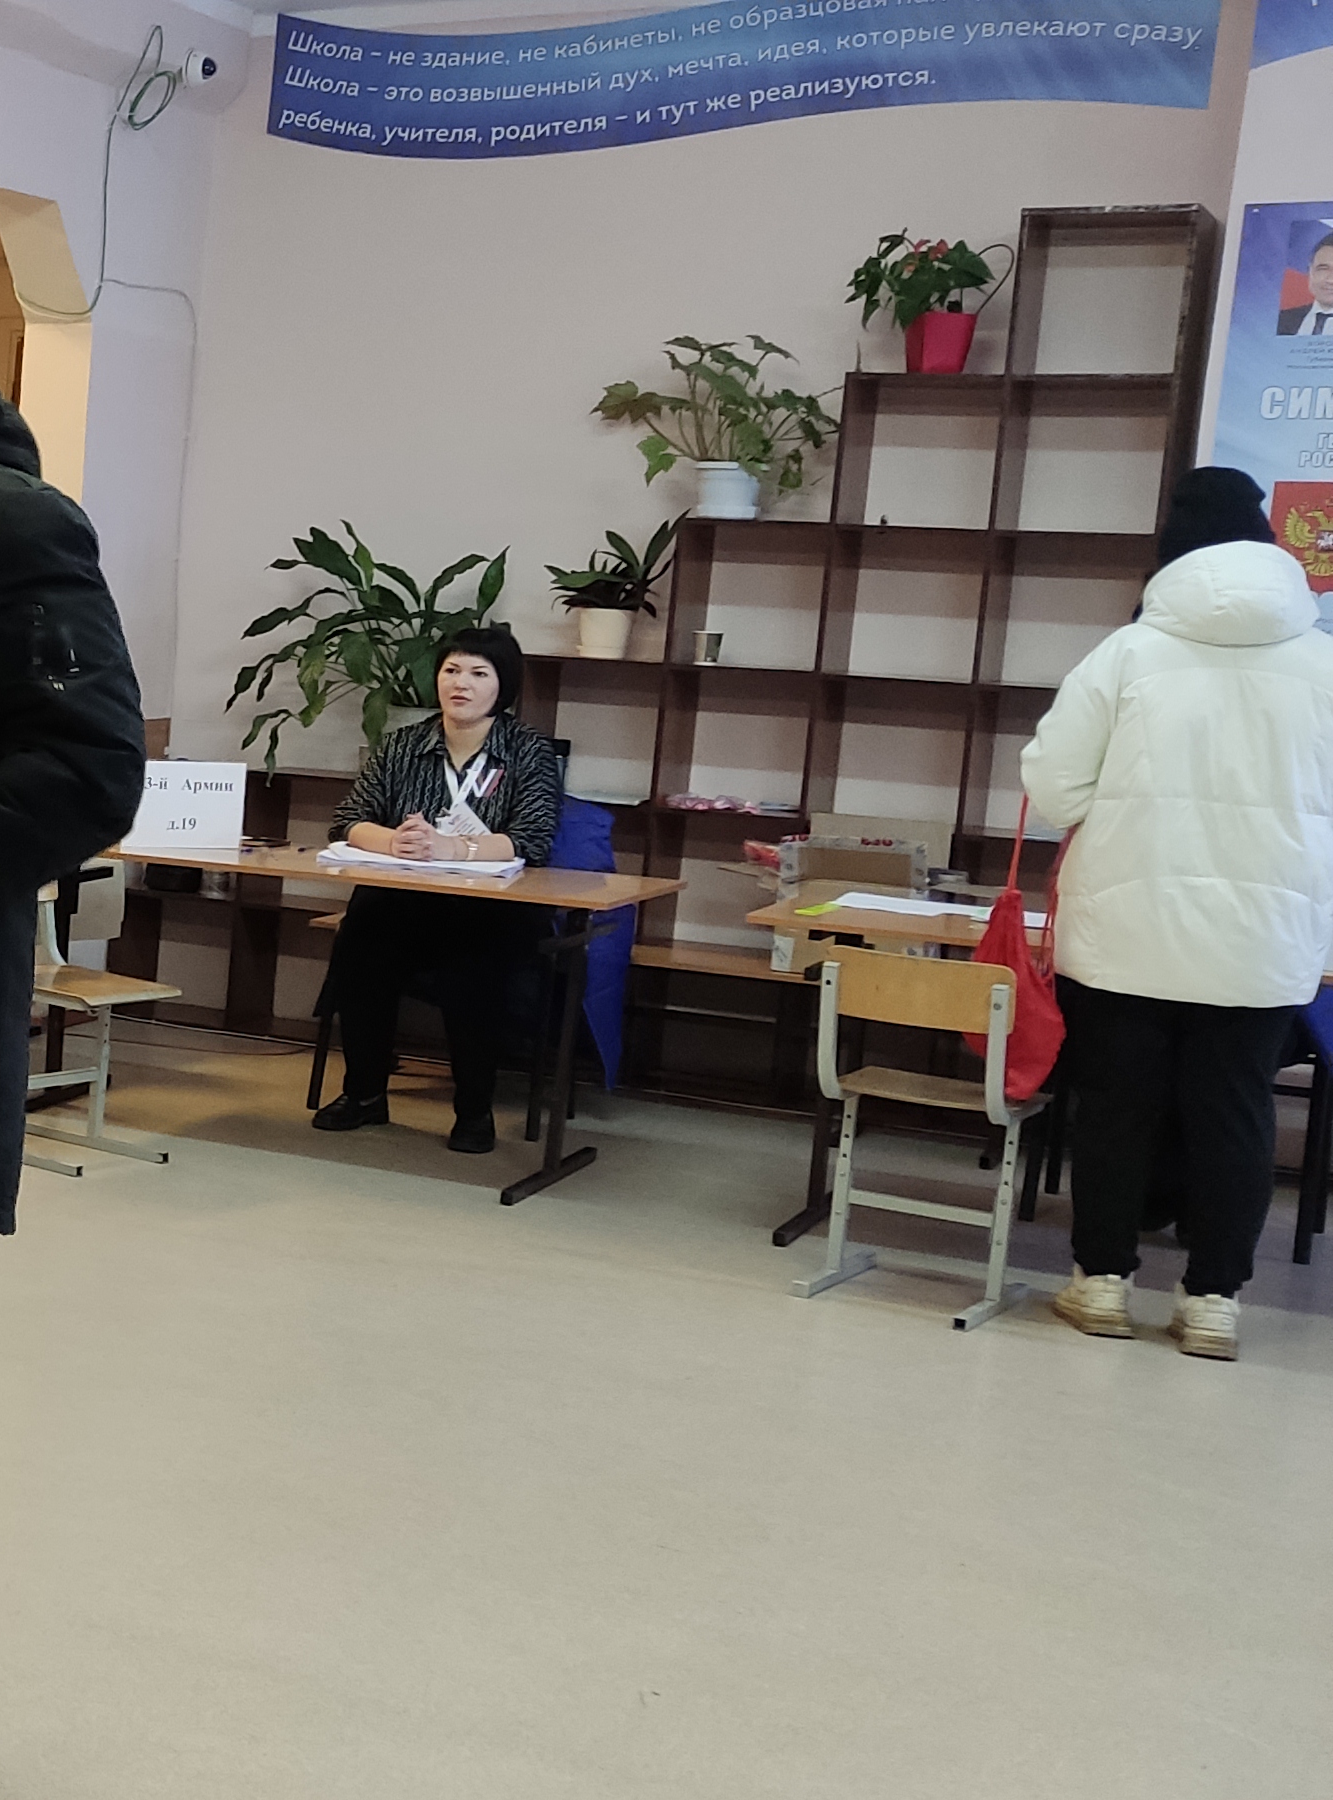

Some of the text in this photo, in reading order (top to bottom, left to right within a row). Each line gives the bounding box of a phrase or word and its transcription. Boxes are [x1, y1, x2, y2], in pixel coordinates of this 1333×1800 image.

[284, 65, 359, 96] Школа
[384, 86, 423, 102] это
[430, 72, 601, 102] возвышенный
[609, 70, 659, 92] дух,
[758, 38, 827, 62] идея,
[836, 24, 955, 49] которые
[963, 19, 1106, 45] увлекают
[288, 30, 363, 61] Школа
[388, 50, 415, 65] не
[421, 50, 511, 69] здание,
[519, 46, 546, 62] не
[554, 27, 682, 59] кабинеты,
[691, 18, 721, 37] не
[278, 108, 376, 140] ребенка,
[382, 124, 482, 146] учителя,
[490, 113, 606, 147] родителя
[636, 109, 650, 125] и
[658, 100, 698, 125] тут
[706, 93, 741, 113] же
[749, 69, 936, 112] реализуются.
[144, 776, 234, 794] 3-й Армии
[166, 817, 197, 831] д.19
